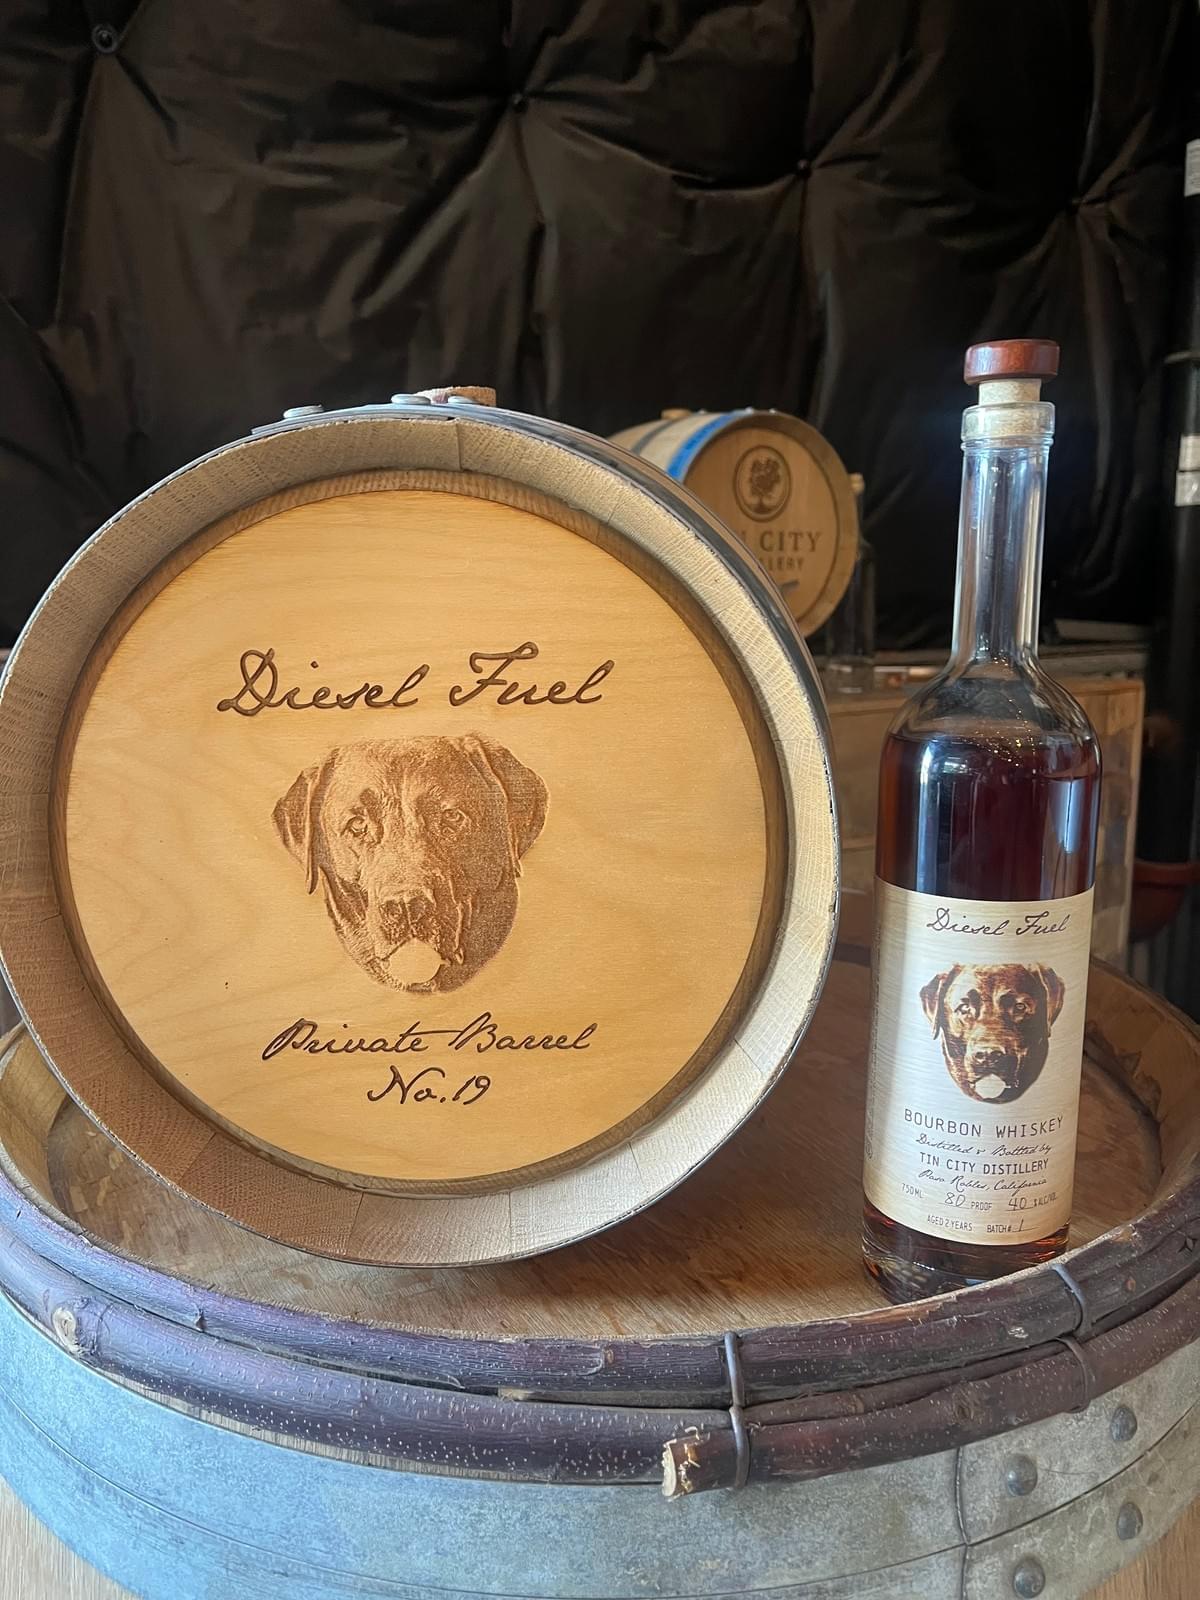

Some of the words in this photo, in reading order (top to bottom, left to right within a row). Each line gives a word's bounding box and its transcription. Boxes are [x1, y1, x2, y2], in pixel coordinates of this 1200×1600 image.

[760, 529, 822, 552] CITY
[217, 647, 430, 717] Diesel
[449, 641, 616, 707] Fuel
[926, 907, 1010, 936] Diesel
[1015, 910, 1071, 936] Fuel
[262, 1017, 430, 1061] Private
[447, 1011, 599, 1053] Barrel
[452, 1074, 491, 1105] 19
[904, 1108, 982, 1138] BOURBON
[995, 1116, 1064, 1138] WHISKEY
[915, 1132, 974, 1155] Distilled
[919, 1151, 940, 1167] TIN
[946, 1158, 976, 1174] CITY
[983, 1158, 1049, 1175] DISTILLERY
[918, 1169, 945, 1182] Paso
[950, 1175, 990, 1193] Robles,
[993, 1178, 1047, 1196] California
[970, 1201, 993, 1211] PROOF
[1008, 1197, 1027, 1211] 40
[927, 1214, 944, 1226] AGED
[944, 1217, 951, 1228] 2
[951, 1219, 973, 1232] YEARS
